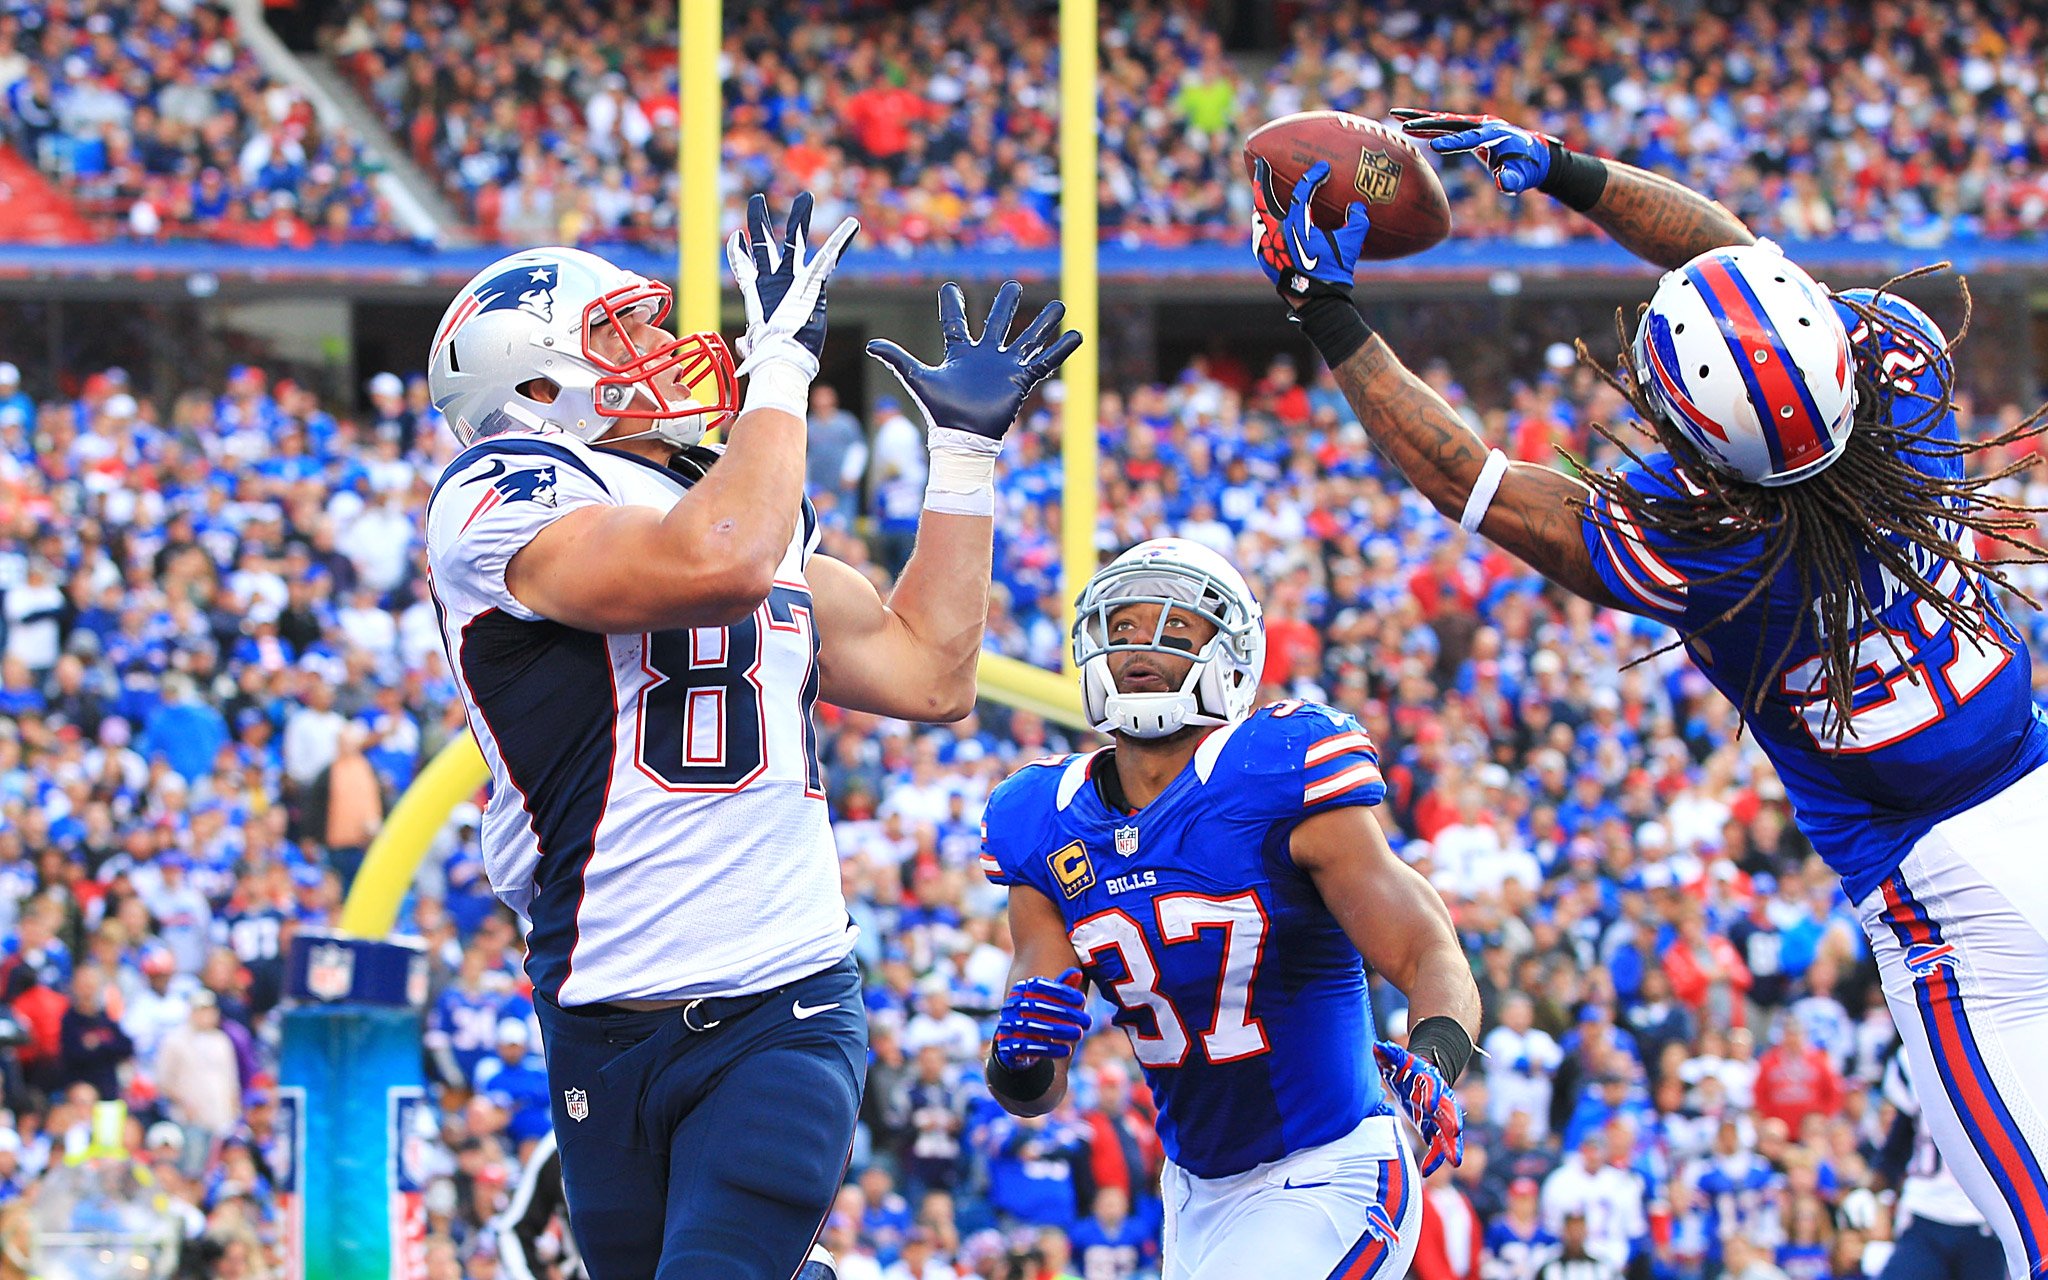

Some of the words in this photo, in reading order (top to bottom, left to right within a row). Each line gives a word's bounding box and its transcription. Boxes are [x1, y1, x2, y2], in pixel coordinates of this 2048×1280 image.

[1362, 168, 1392, 196] NFL
[1779, 506, 2015, 755] 27
[634, 581, 826, 801] 87
[1119, 839, 1135, 851] NFL
[1053, 845, 1087, 884] C
[1105, 870, 1157, 896] BILLS
[1067, 889, 1271, 1069] 37
[570, 1102, 586, 1116] NFL
